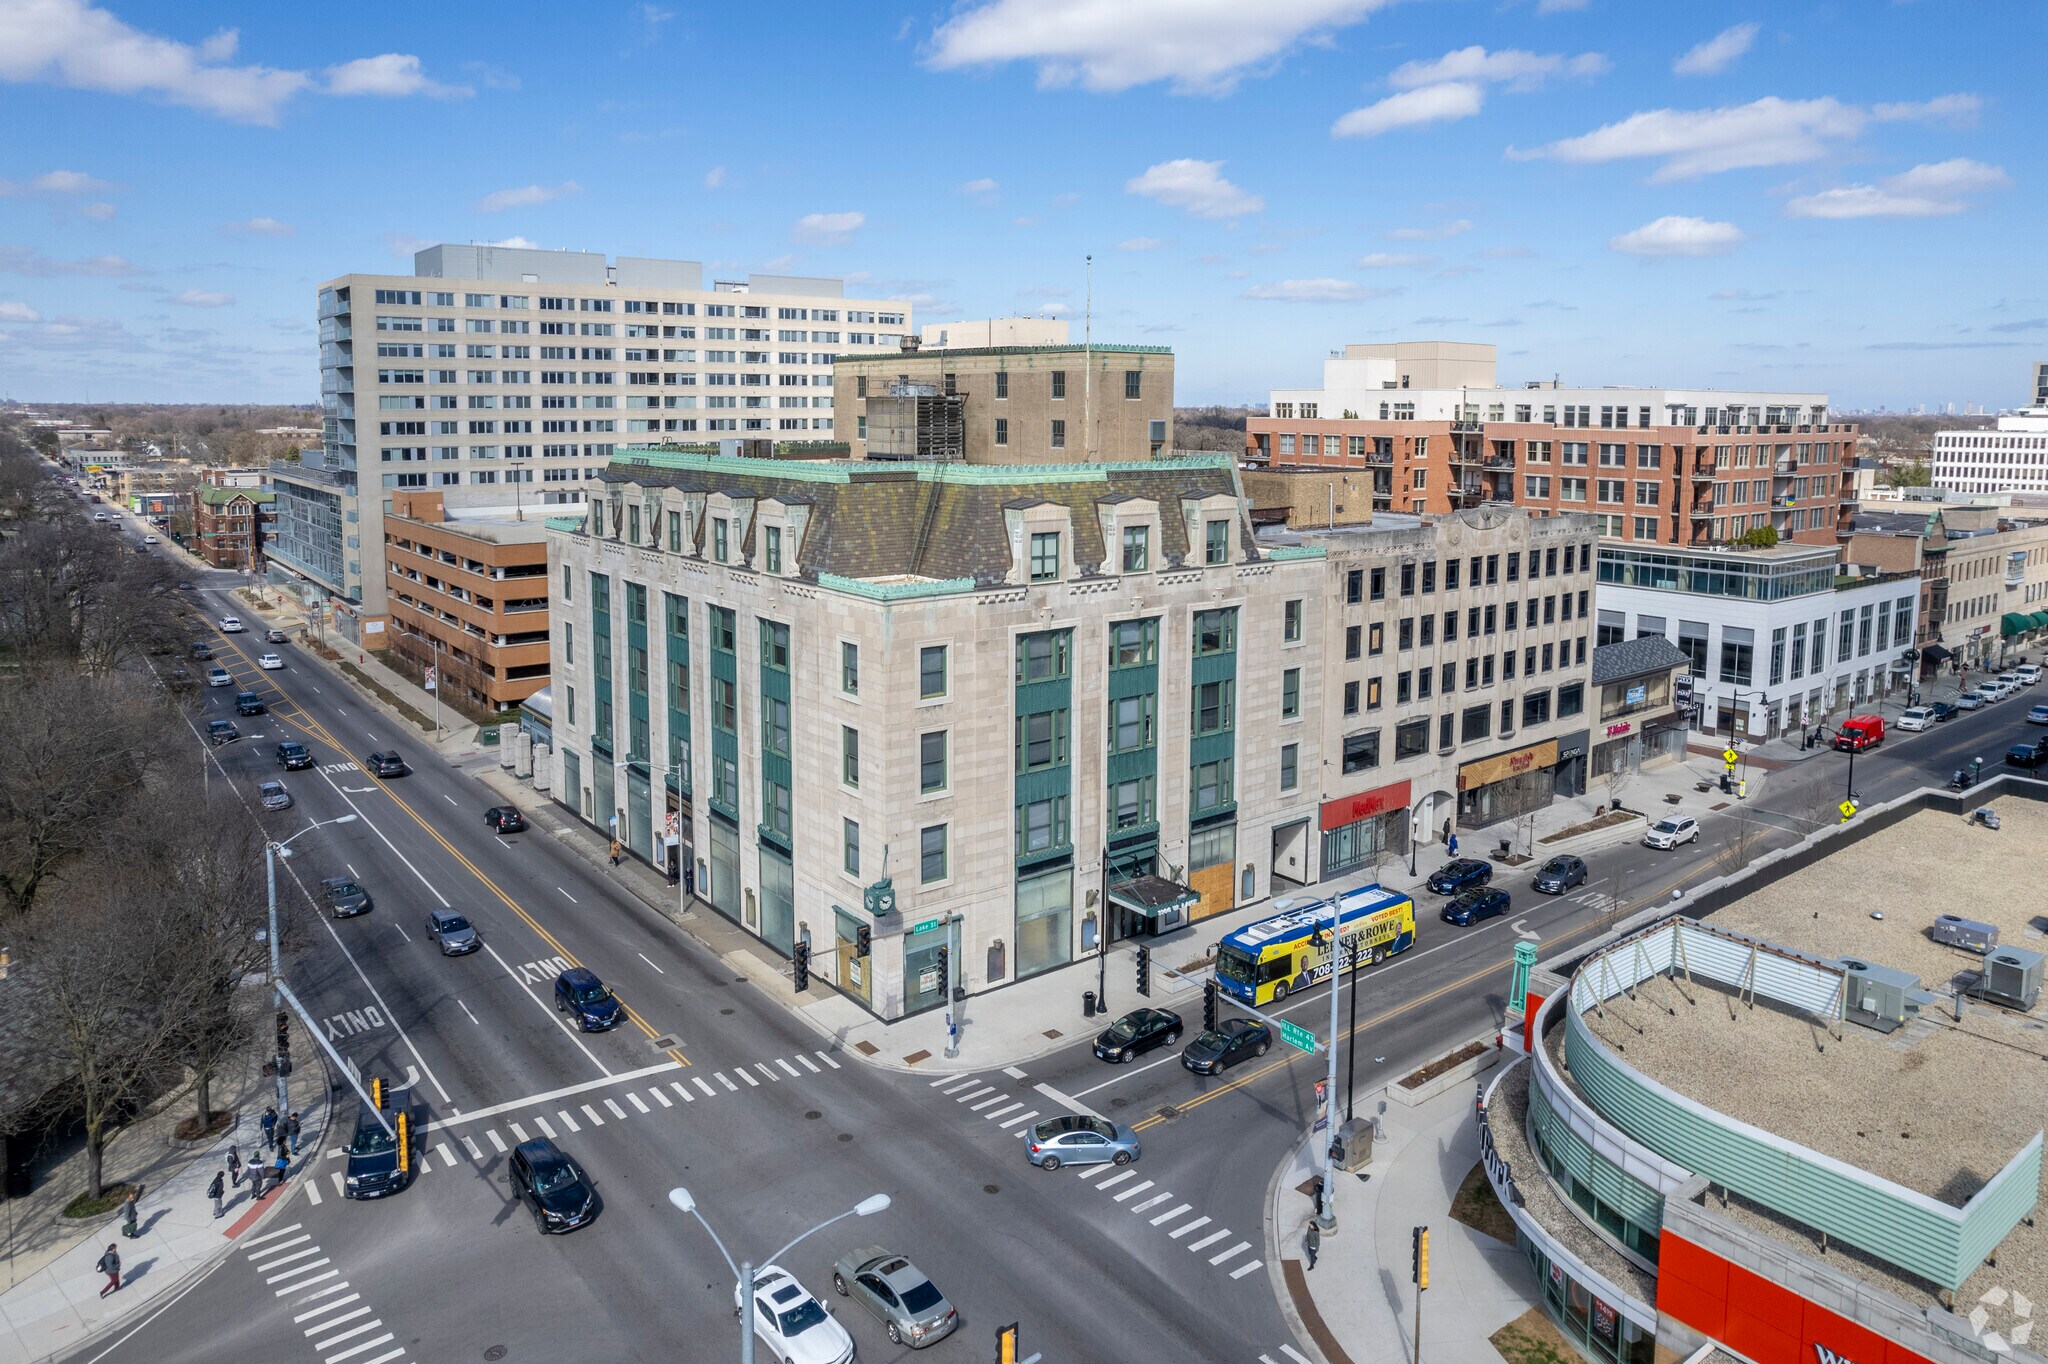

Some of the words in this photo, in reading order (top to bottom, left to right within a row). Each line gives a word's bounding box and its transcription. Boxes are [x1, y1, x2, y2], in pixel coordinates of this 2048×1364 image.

[323, 762, 360, 775] ONLY
[1371, 911, 1389, 923] VOTED
[915, 924, 929, 932] Lake
[930, 921, 937, 929] St
[517, 956, 574, 985] ONLY
[1313, 948, 1373, 979] 708-22-222
[323, 1006, 386, 1041] ONLY
[1282, 1031, 1304, 1047] Harlem
[1305, 1043, 1314, 1052] Av
[1305, 1033, 1314, 1043] 43
